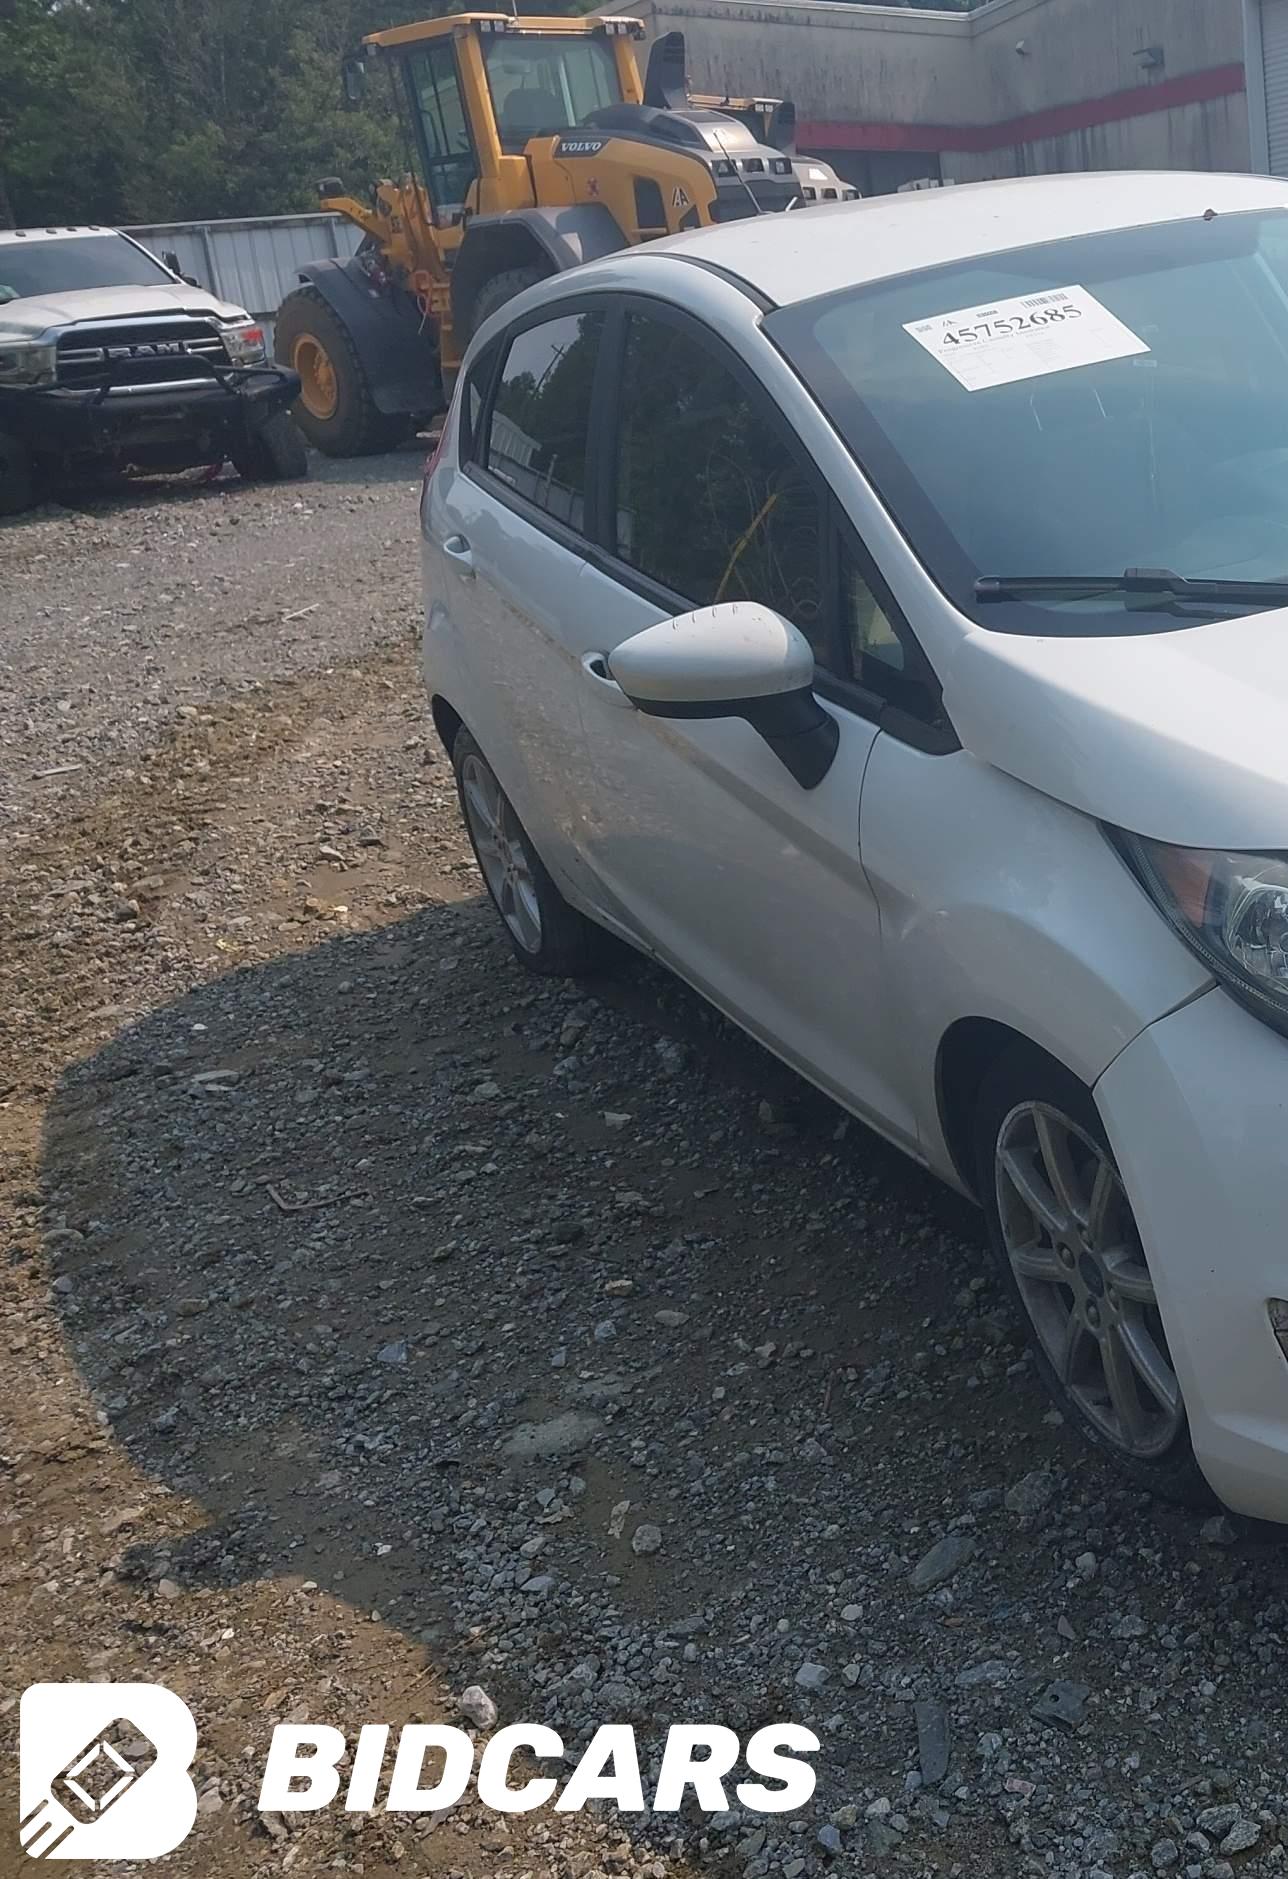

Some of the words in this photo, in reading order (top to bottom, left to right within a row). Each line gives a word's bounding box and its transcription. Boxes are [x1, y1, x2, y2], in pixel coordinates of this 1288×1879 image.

[561, 141, 602, 152] VOLVO
[943, 304, 1082, 345] 45752685
[107, 342, 179, 359] RAM
